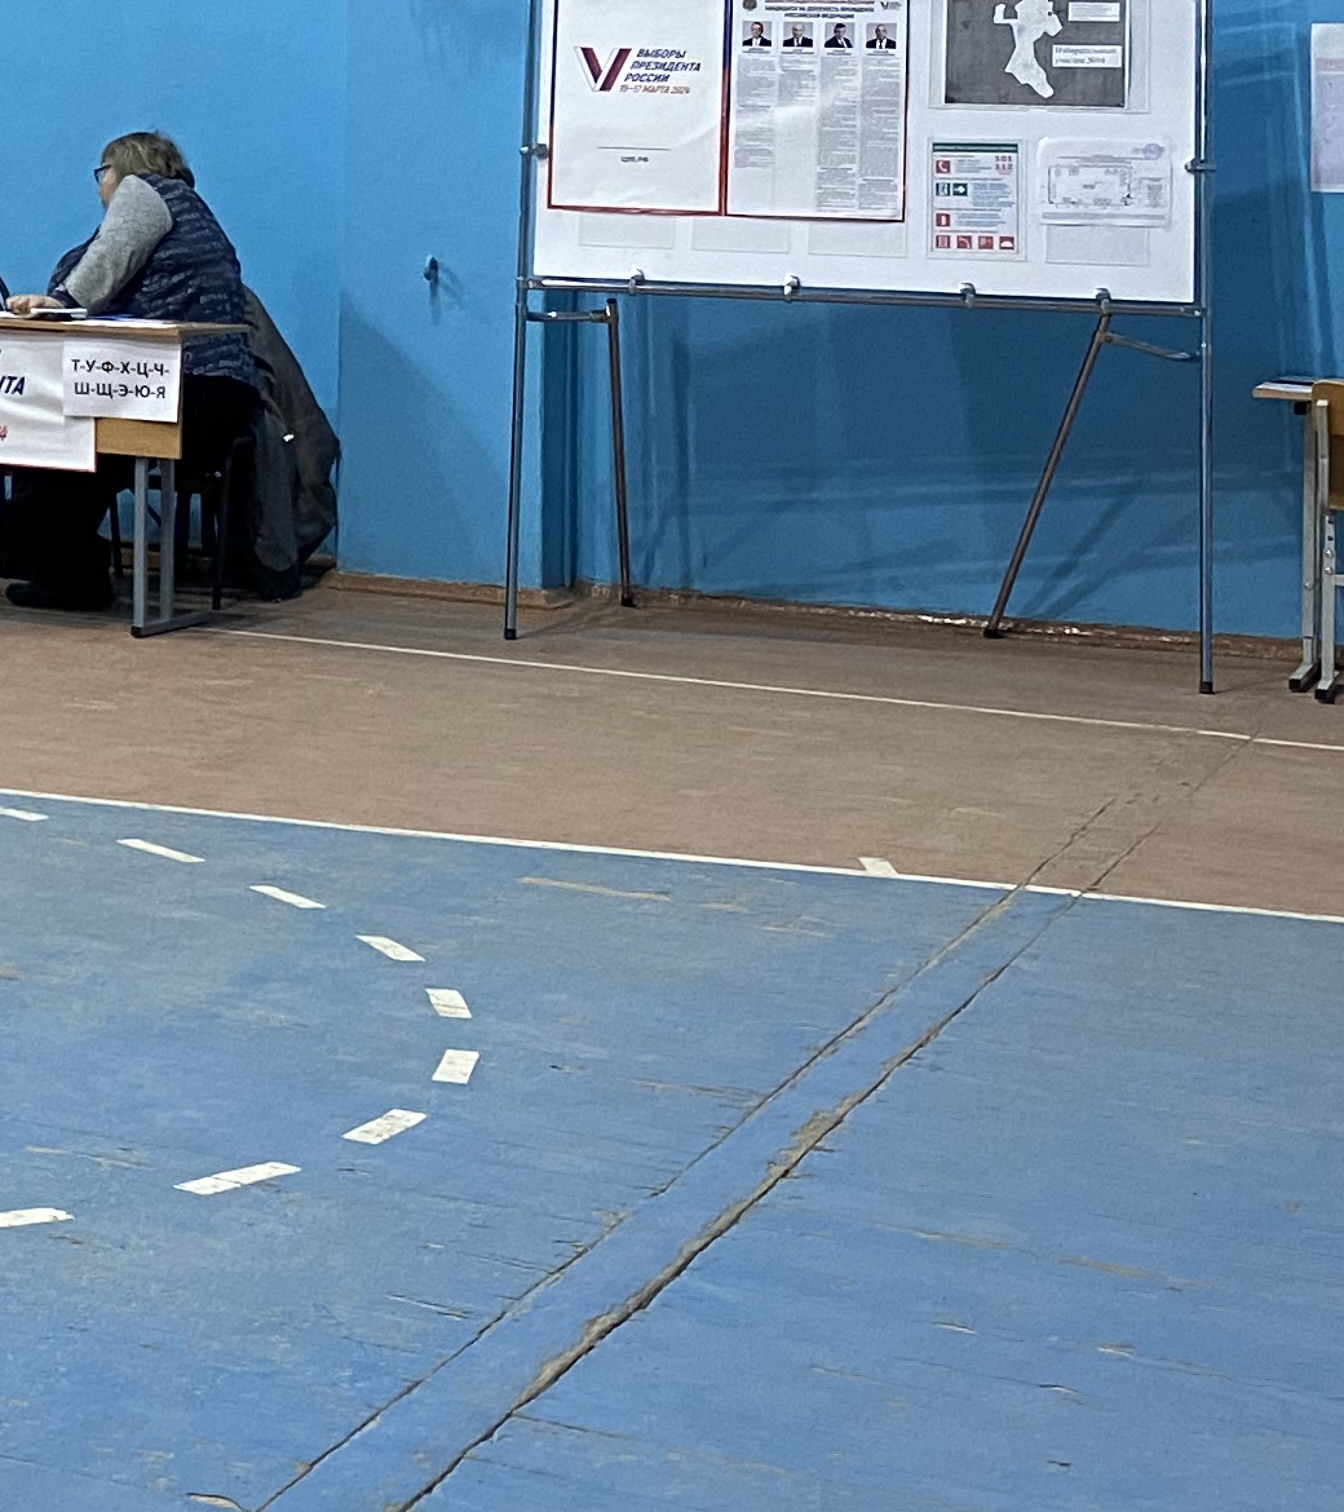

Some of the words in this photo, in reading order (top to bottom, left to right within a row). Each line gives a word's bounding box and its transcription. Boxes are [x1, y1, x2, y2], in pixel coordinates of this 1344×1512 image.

[636, 48, 687, 59] ВЫБОРЫ
[630, 60, 701, 72] ПРЕЗИДЕНТА
[623, 72, 670, 83] РОССИИ
[71, 358, 170, 379] Т-У-Ф-Х-Ц-Ч-
[74, 381, 165, 399] Ш-Щ-Э-Ю-Я
